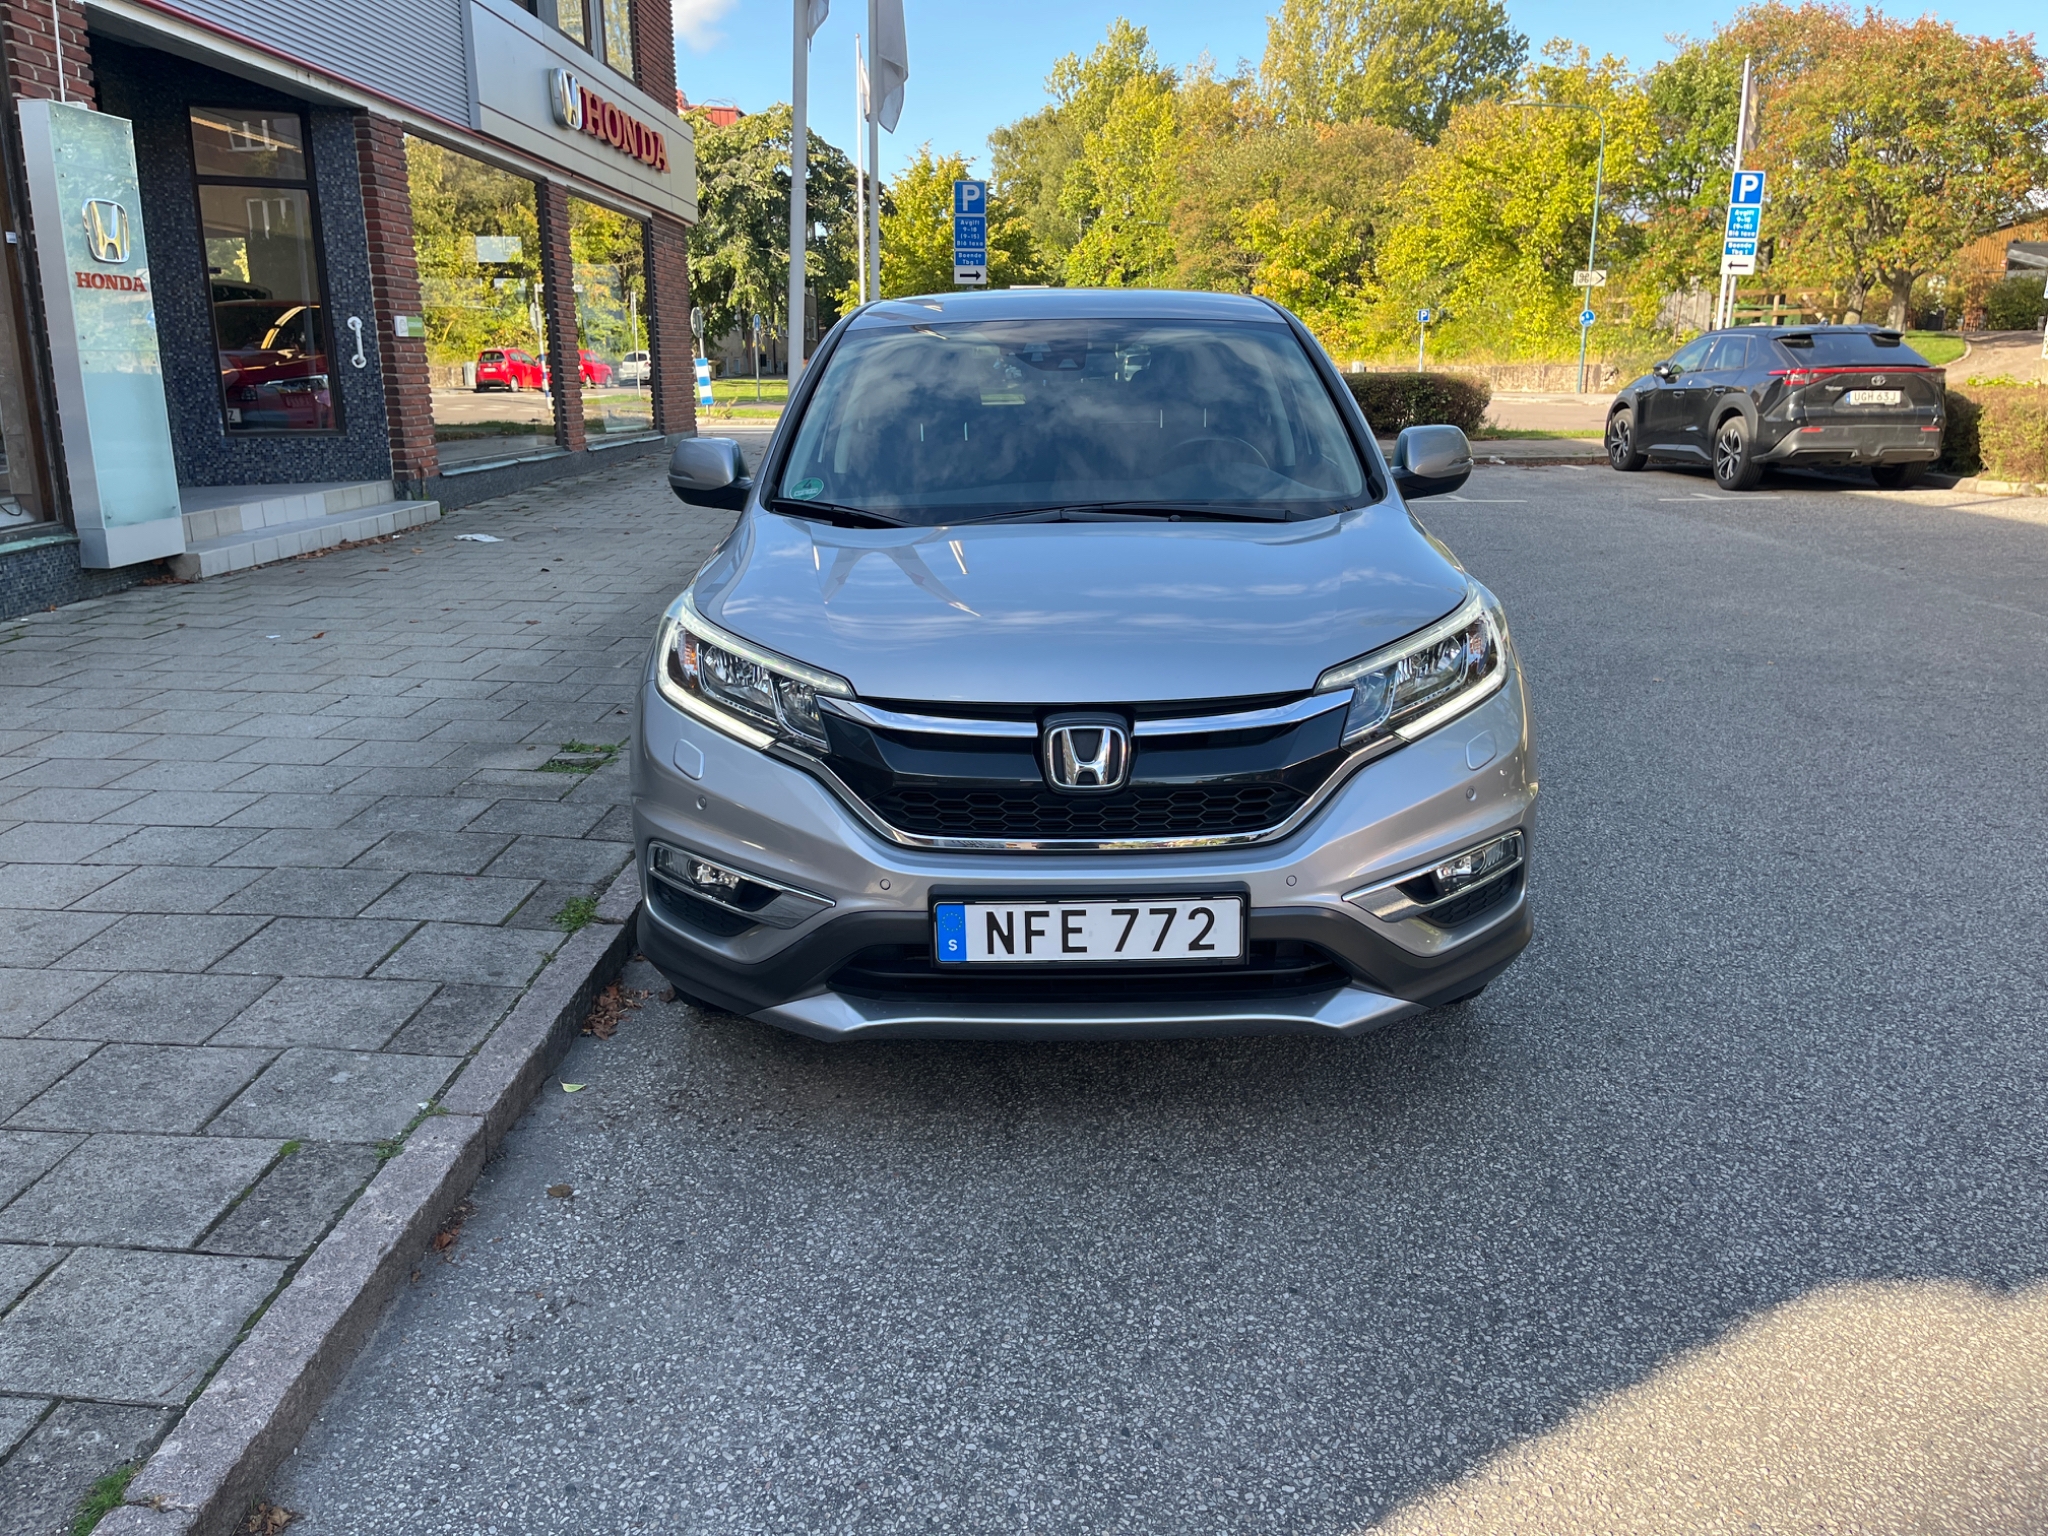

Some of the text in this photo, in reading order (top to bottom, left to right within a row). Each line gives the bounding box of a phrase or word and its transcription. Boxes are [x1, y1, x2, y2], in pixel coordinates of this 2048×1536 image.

[580, 86, 671, 174] HONDA
[962, 184, 980, 211] P
[1739, 174, 1759, 202] P
[75, 271, 148, 293] HONDA
[1854, 392, 1874, 401] UGH
[985, 907, 1215, 955] NFE 772
[948, 939, 958, 951] S
